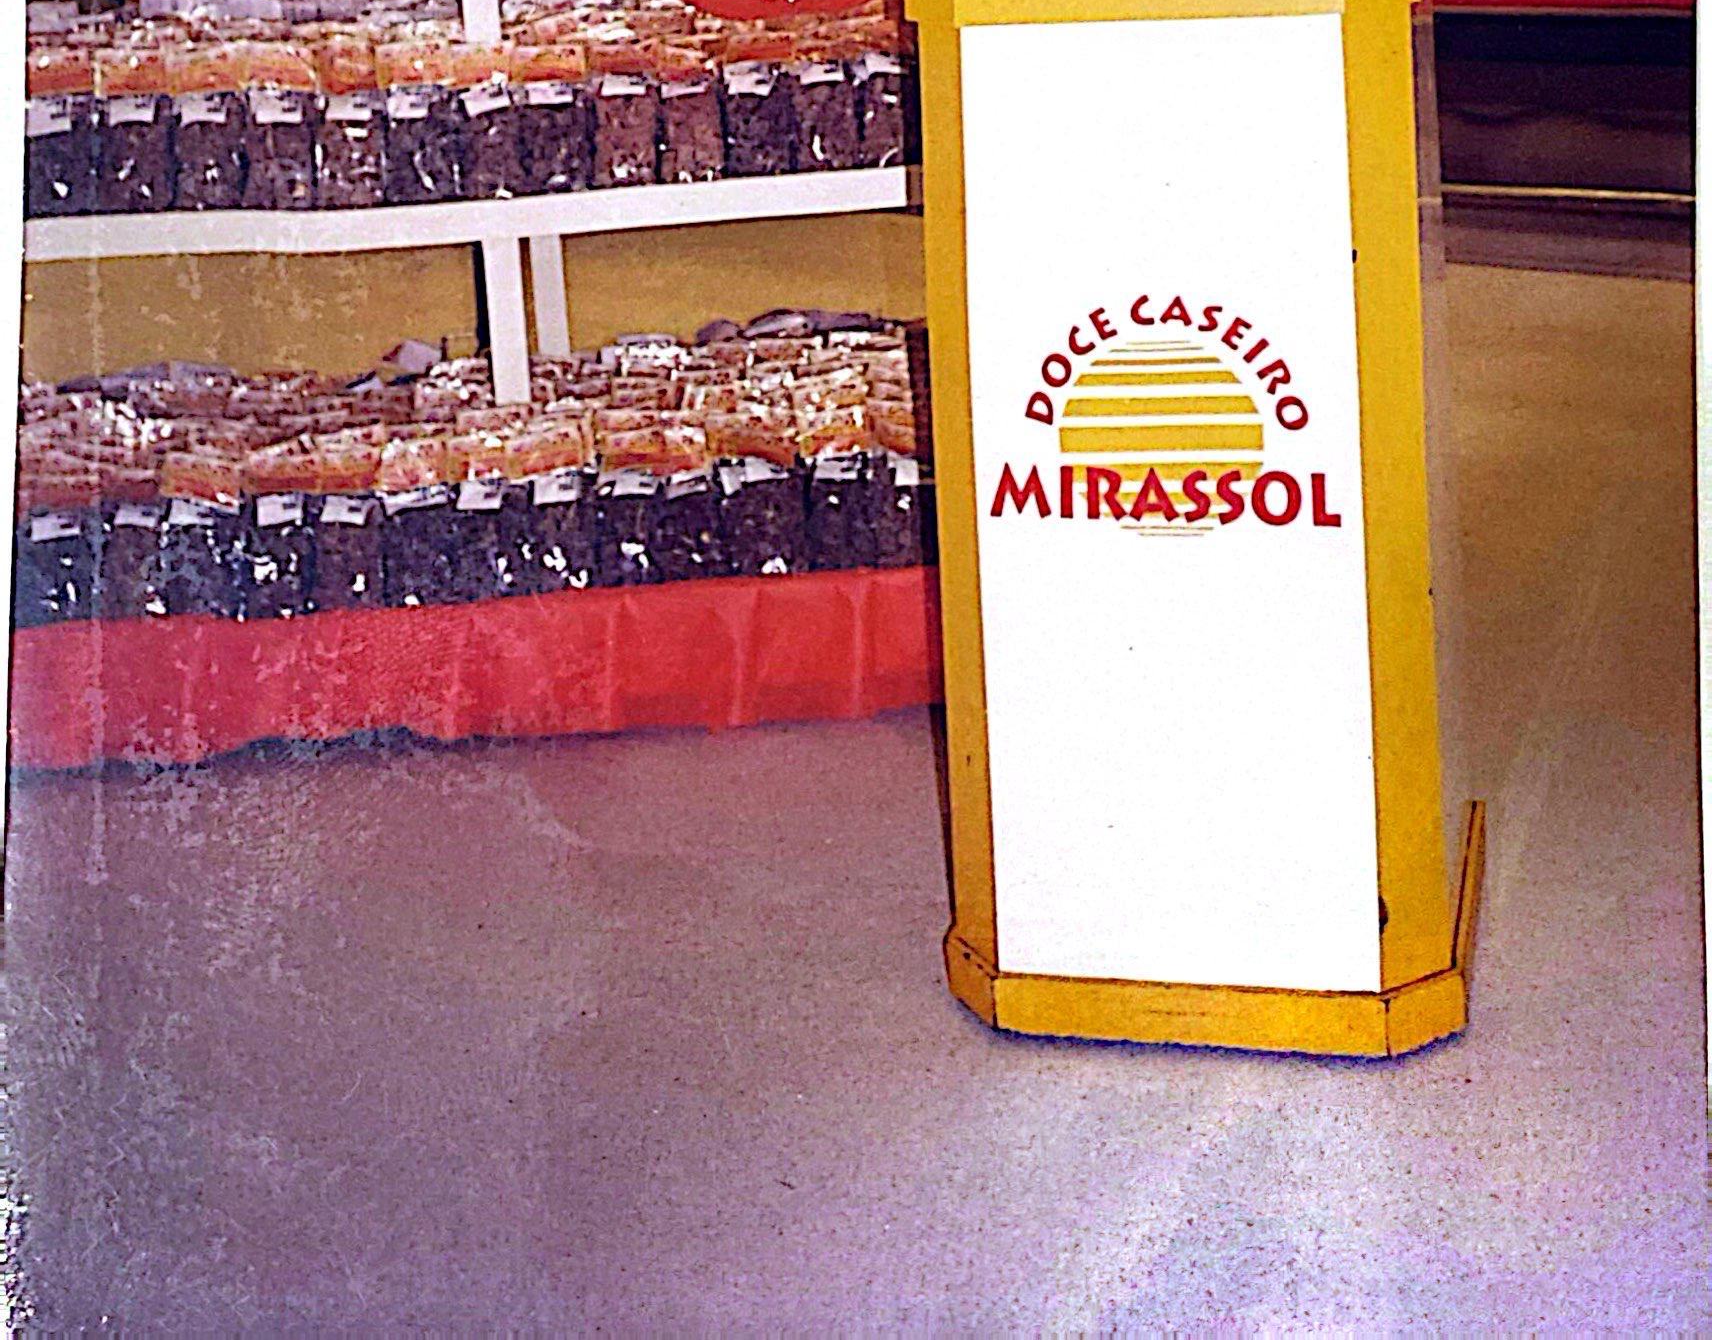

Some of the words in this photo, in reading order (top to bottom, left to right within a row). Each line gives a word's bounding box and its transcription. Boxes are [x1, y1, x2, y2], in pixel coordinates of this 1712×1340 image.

[1024, 307, 1118, 426] DOCE
[1130, 294, 1309, 431] CASEIRO
[989, 461, 1343, 528] MIRASSOL
